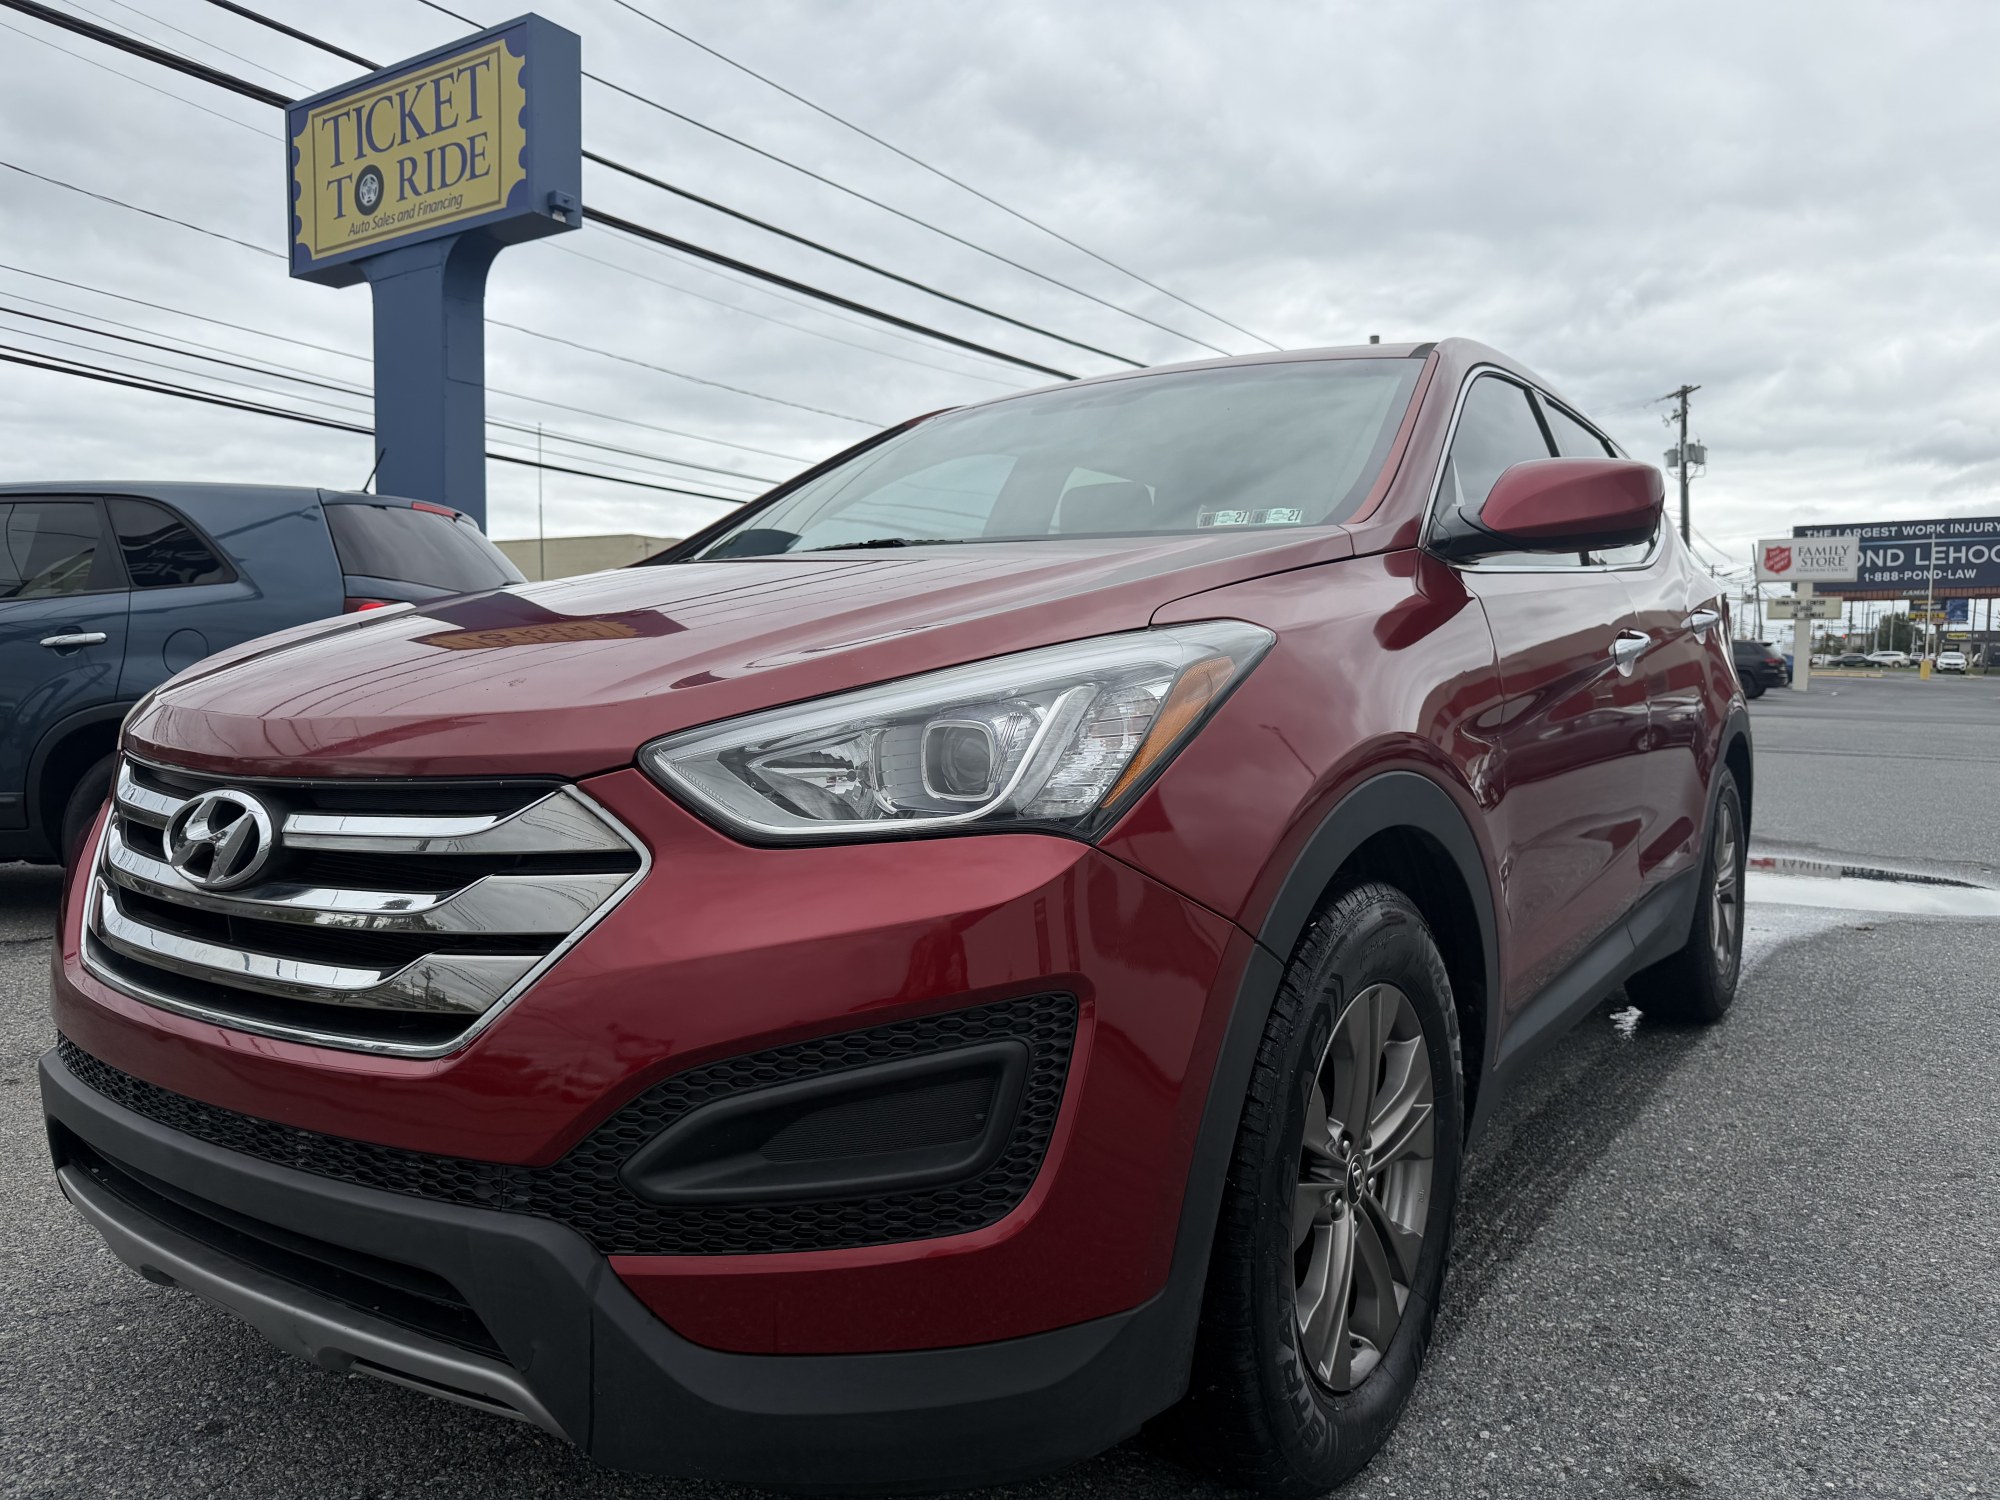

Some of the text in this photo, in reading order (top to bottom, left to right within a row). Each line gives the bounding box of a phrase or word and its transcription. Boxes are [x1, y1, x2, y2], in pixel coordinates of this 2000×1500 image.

[321, 57, 490, 168] TICKET
[326, 132, 491, 220] TO RIDE
[348, 193, 463, 237] Auto Sales and Financing
[1234, 511, 1248, 523] 27
[1287, 509, 1301, 521] 27
[1902, 524, 1945, 535] WORK
[1798, 545, 1850, 557] FAMILY
[1800, 556, 1845, 567] STORE
[1857, 548, 1904, 568] ND
